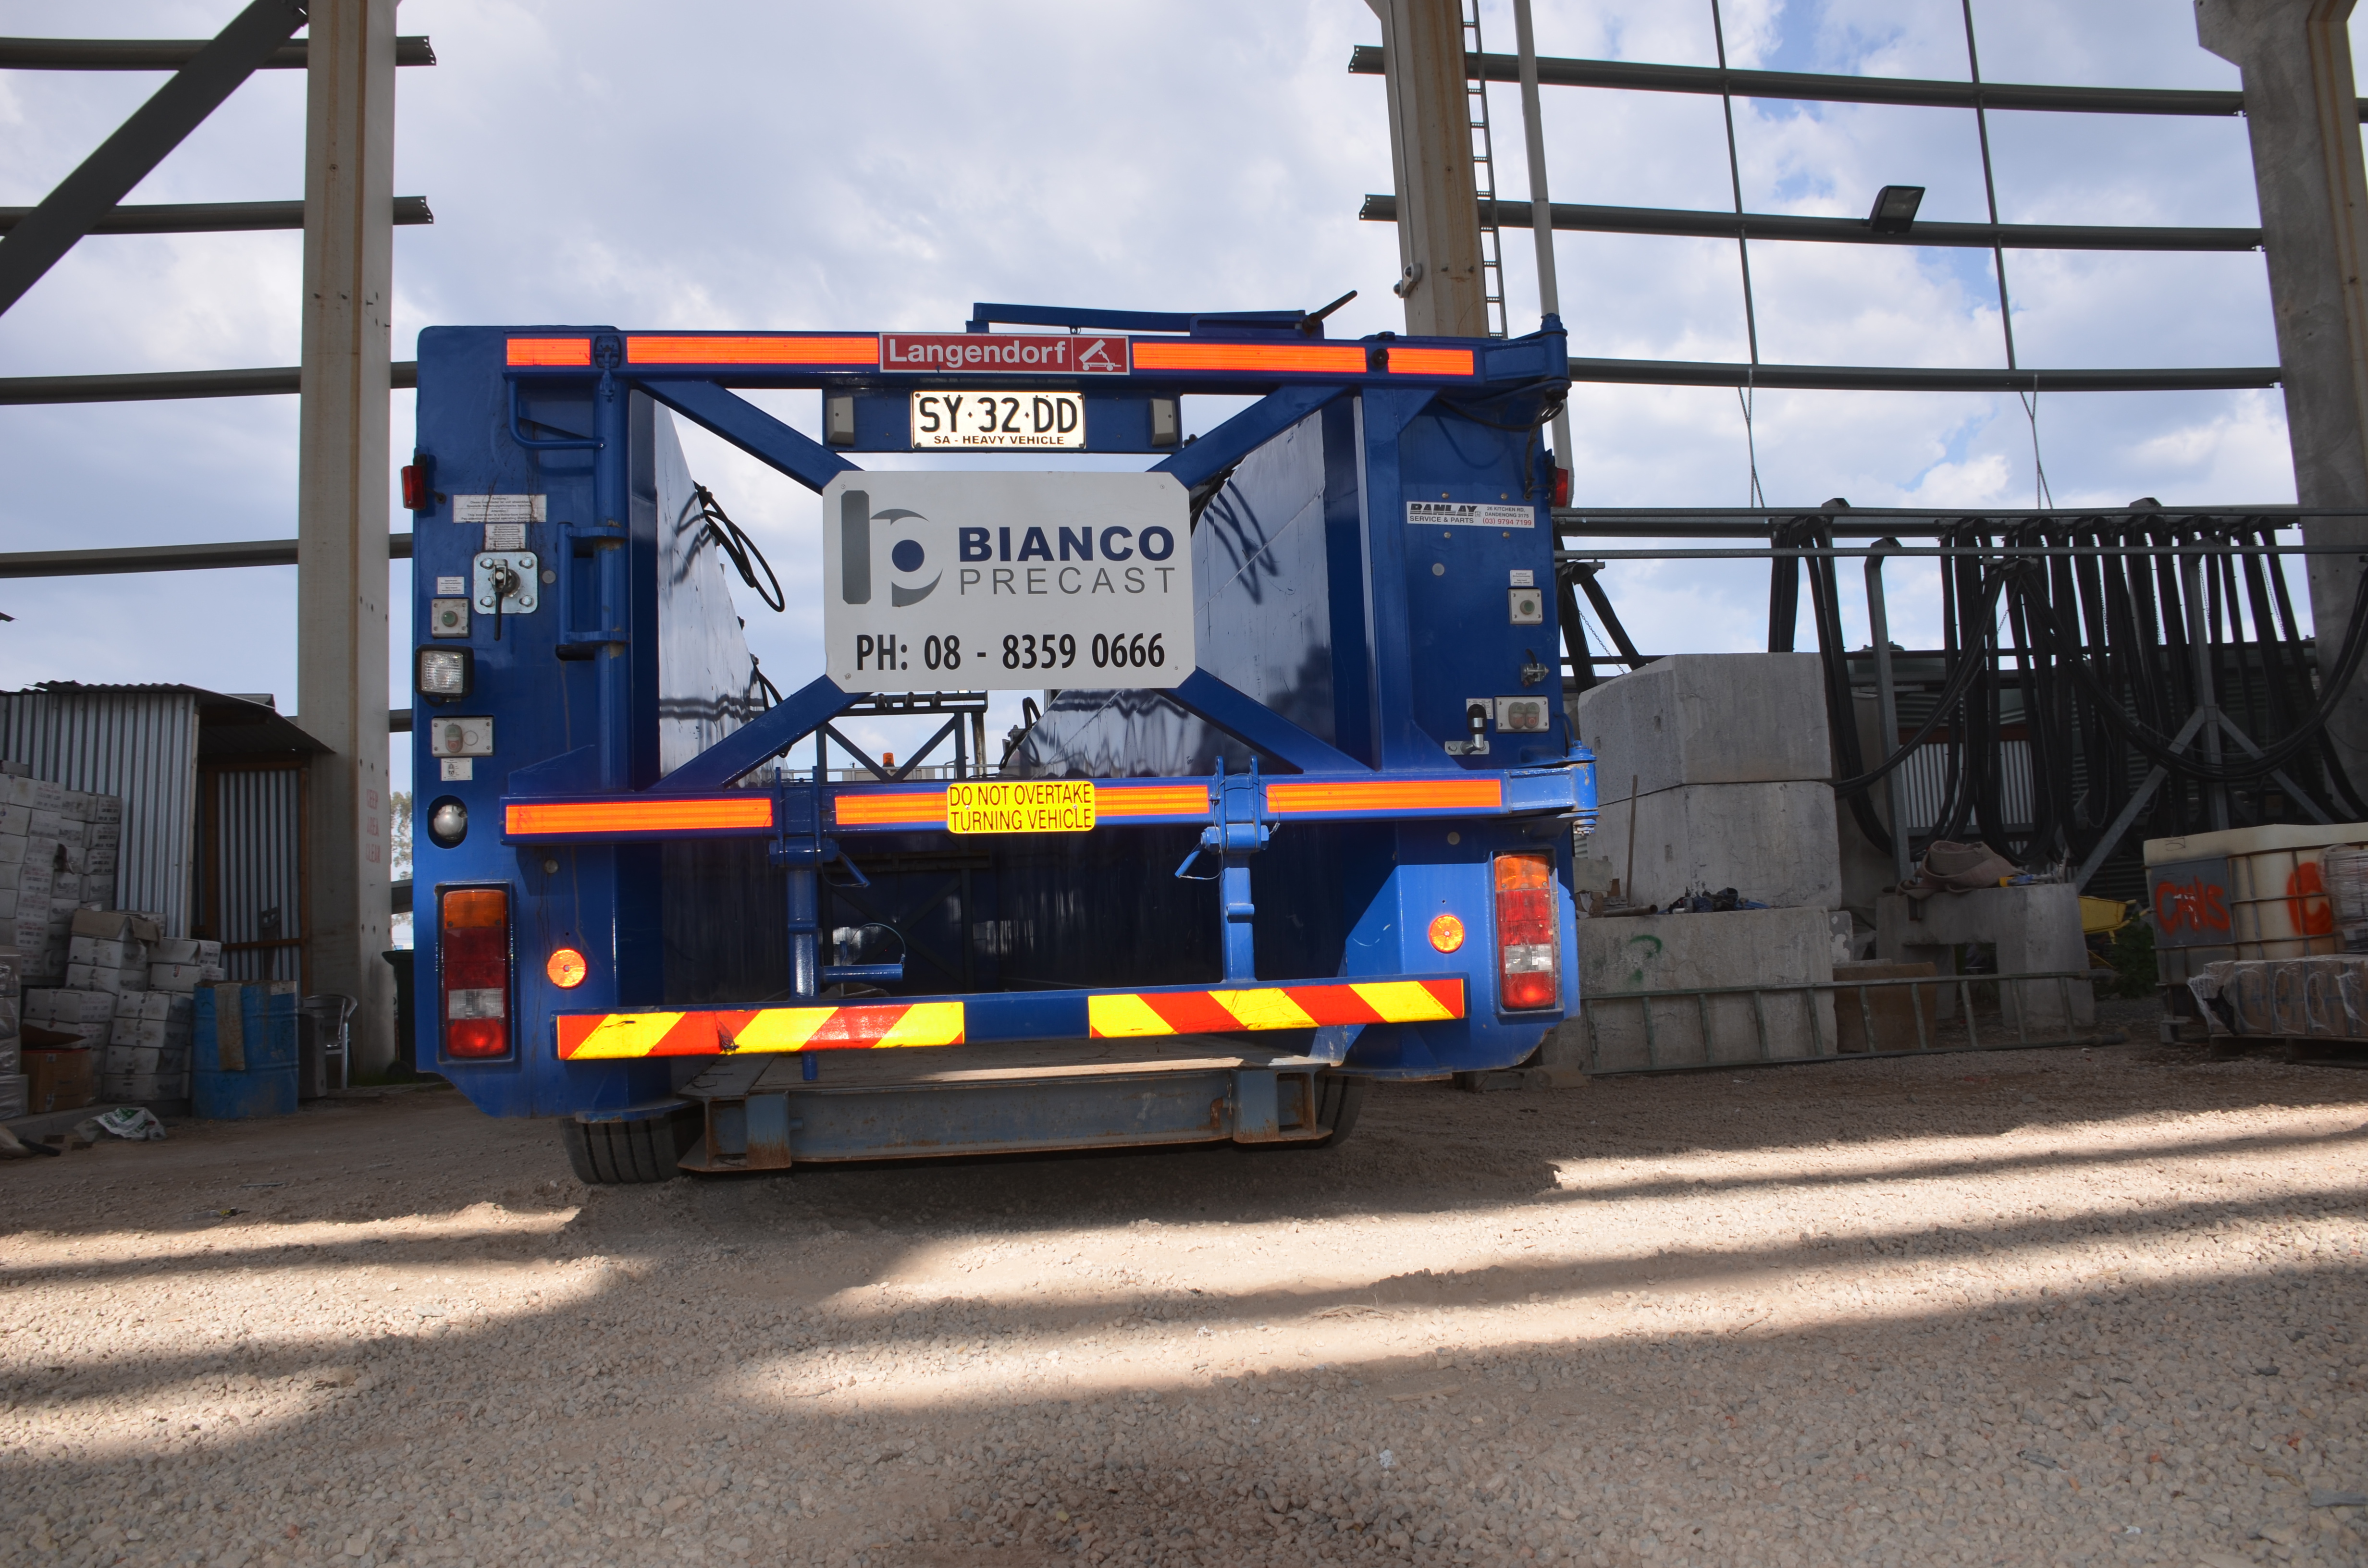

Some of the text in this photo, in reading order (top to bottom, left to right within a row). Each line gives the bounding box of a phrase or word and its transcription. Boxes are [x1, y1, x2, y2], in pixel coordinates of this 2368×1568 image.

[889, 339, 1066, 368] Langendorf
[934, 436, 951, 444] SA
[962, 436, 1005, 444] HEAVY
[1010, 436, 1064, 444] VEHICLE
[959, 526, 1175, 562] BIANCO
[961, 567, 1175, 595] PRECAST
[857, 634, 908, 671] PH:
[924, 635, 961, 670] 08
[1002, 634, 1076, 670] 8359
[1092, 632, 1165, 668] 0666
[950, 784, 1092, 807] DO NOT OVERTAKE
[951, 808, 1092, 832] TURNING VEHICLE
